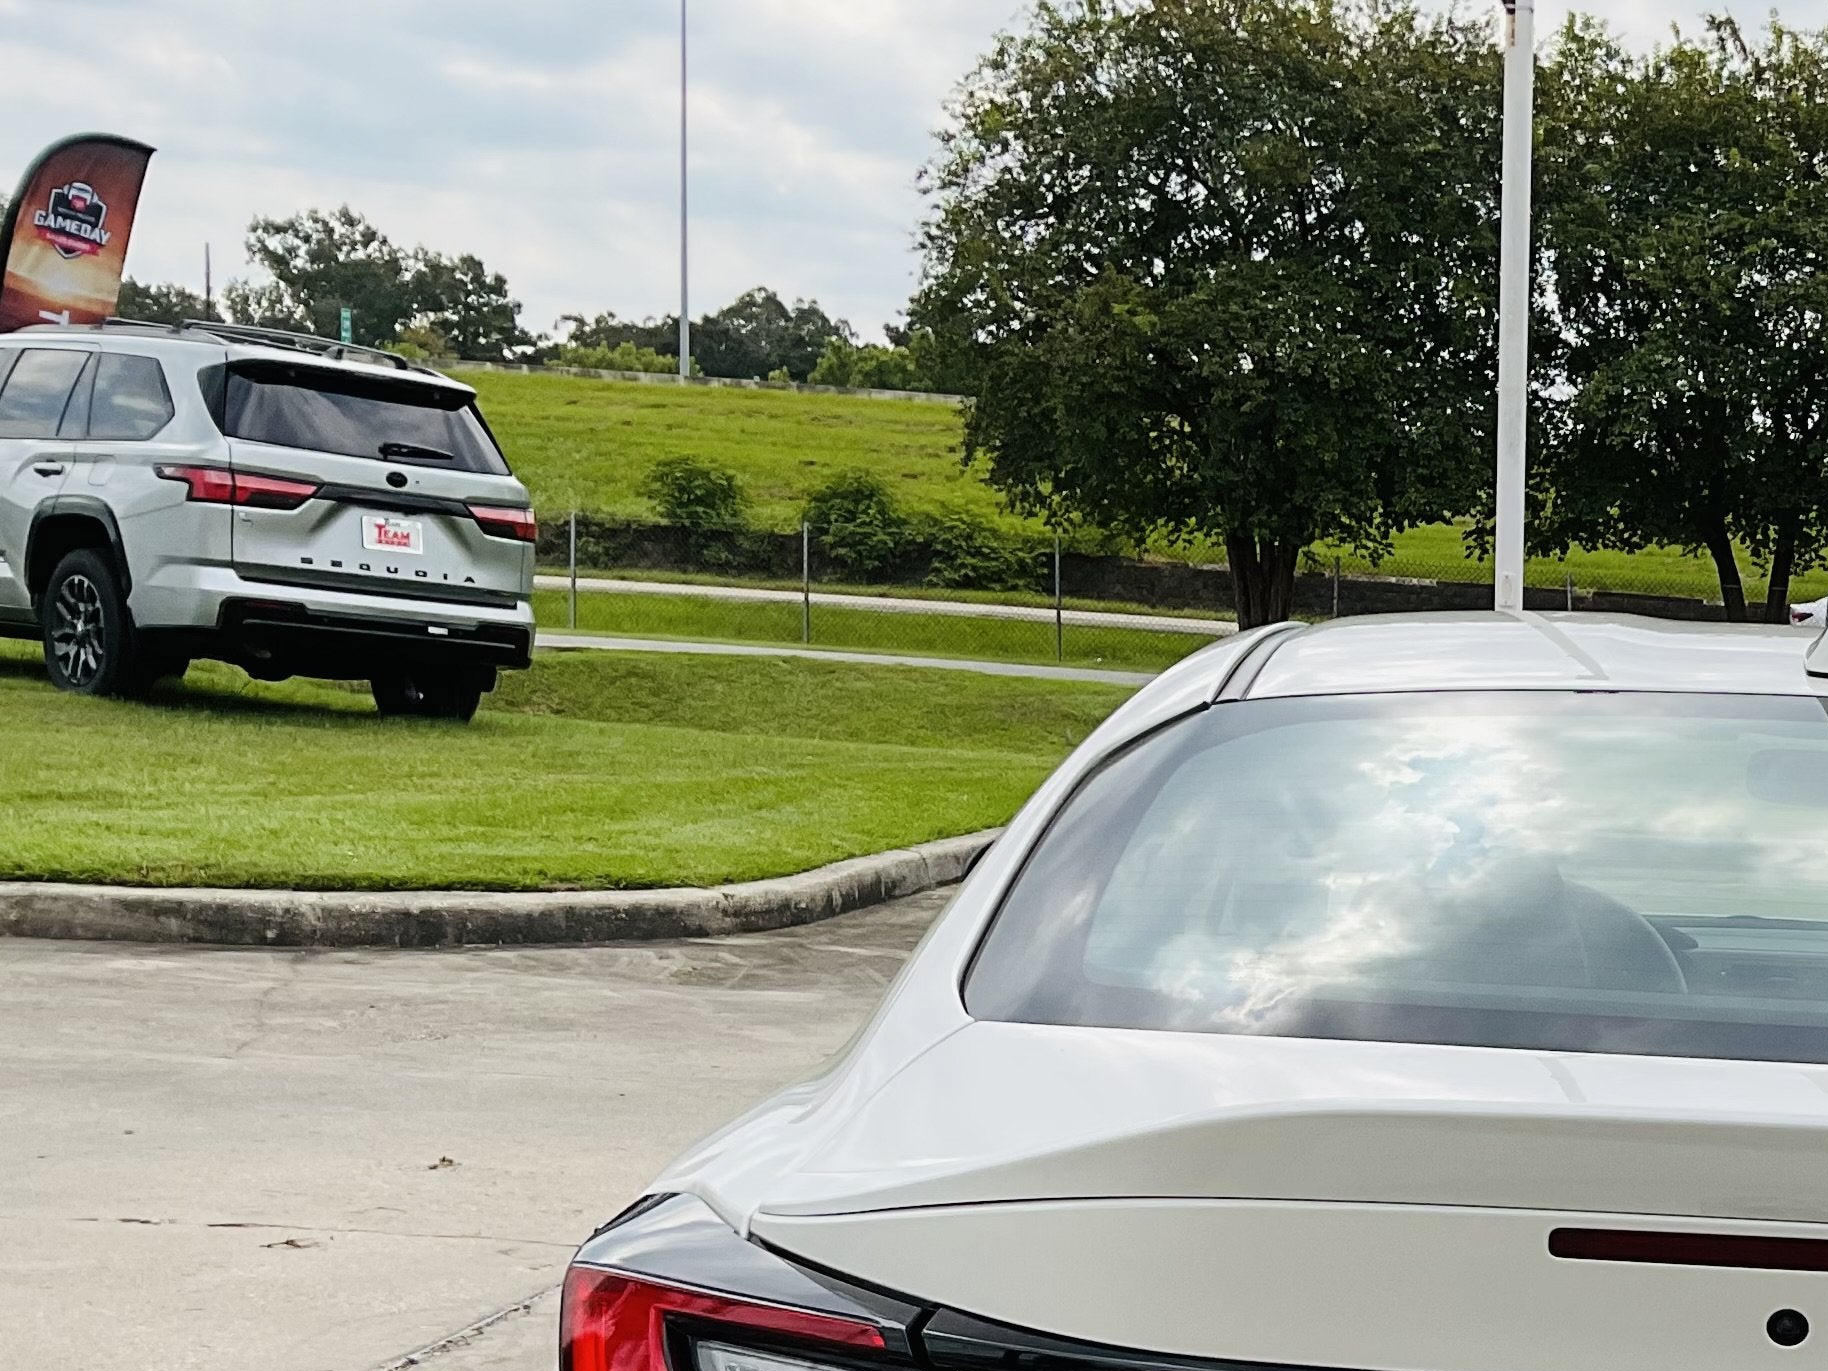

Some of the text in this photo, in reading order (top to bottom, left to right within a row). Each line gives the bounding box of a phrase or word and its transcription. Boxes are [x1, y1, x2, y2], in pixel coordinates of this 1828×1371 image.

[34, 209, 112, 246] GAMEDAY
[374, 523, 410, 542] TEAM
[301, 557, 475, 583] SEQUOIA
